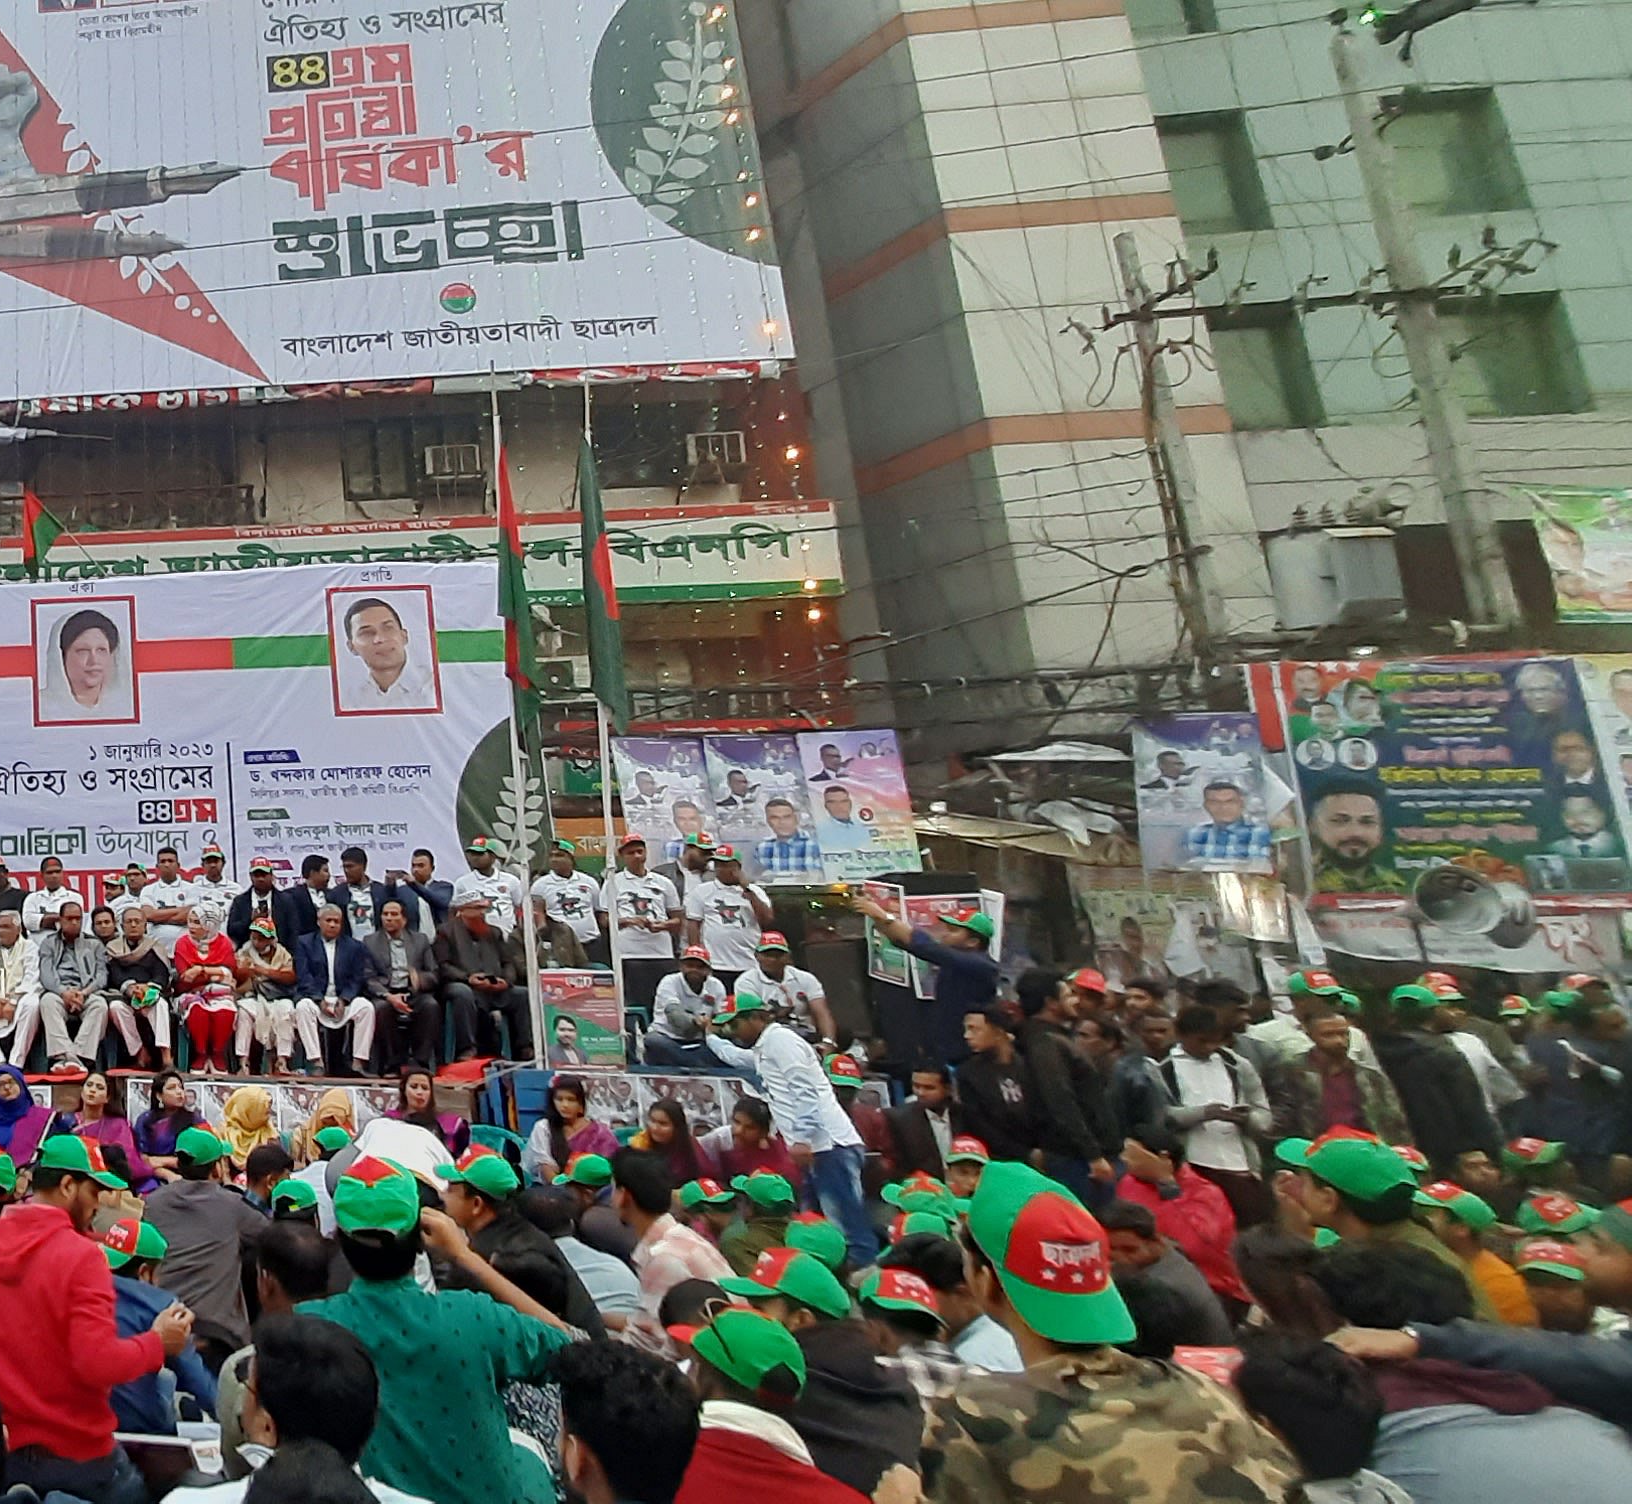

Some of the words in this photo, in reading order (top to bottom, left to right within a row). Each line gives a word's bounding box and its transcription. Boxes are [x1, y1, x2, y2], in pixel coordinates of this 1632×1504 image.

[264, 15, 347, 45] ঐতিহ্য
[364, 15, 381, 36] ও
[392, 2, 503, 34] সংগ্রামের
[282, 331, 393, 358] বাংলাদেশ
[404, 320, 562, 348] জাতীয়তাবাদী
[572, 315, 658, 338] ছাত্রদল
[103, 739, 162, 762] জানুয়ারি
[168, 742, 214, 759] ২০২৩
[79, 769, 97, 792] ও
[108, 763, 214, 792] সংগ্রামের
[387, 764, 432, 780] হোসেন
[95, 825, 189, 859] উদযাপন
[334, 821, 374, 837] ইসলাম
